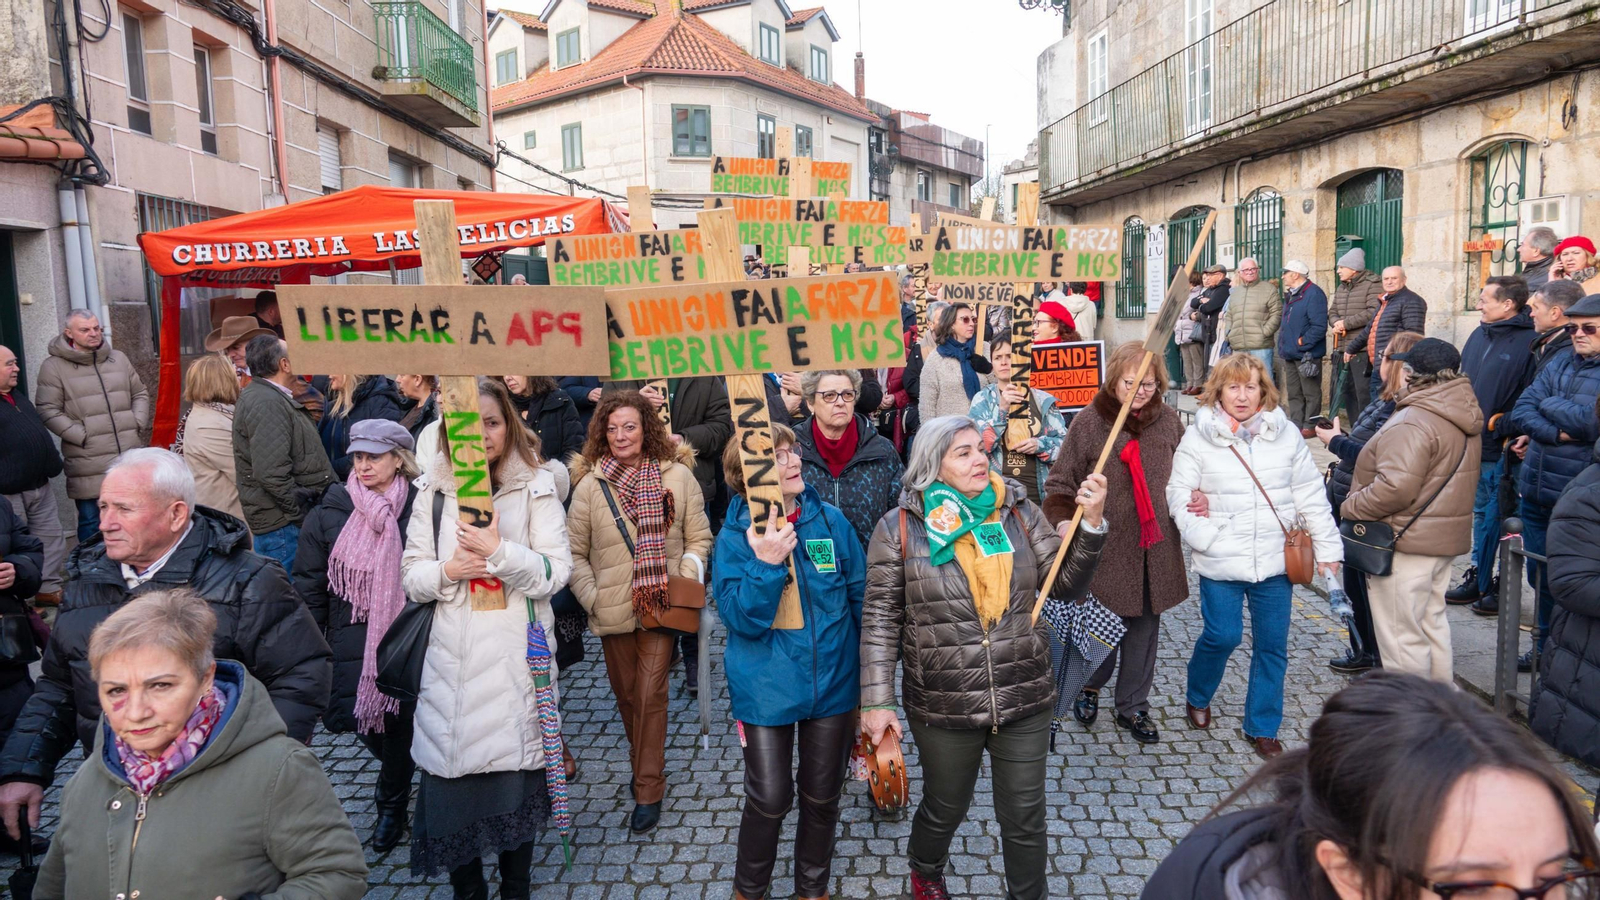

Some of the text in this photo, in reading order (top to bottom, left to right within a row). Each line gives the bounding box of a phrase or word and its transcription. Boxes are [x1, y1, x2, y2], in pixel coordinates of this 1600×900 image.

[713, 155, 725, 173] A
[729, 158, 775, 175] UNION
[811, 162, 848, 179] FORZA
[713, 174, 848, 197] BEMBRIVE MOS
[733, 199, 791, 221] UNION
[796, 200, 824, 221] FAI
[826, 202, 839, 222] A
[839, 201, 888, 223] FORZA
[172, 235, 350, 265] CHURRERIA
[457, 213, 576, 246] ELICIAS
[739, 222, 813, 245] MBRIVE
[823, 224, 835, 246] E
[848, 224, 888, 247] MOS
[935, 227, 1118, 251] A UNION FAI A FORZA
[554, 239, 570, 263] A
[574, 235, 637, 261] UNION
[640, 233, 671, 257] FAI
[673, 234, 686, 253] A
[854, 246, 864, 263] E
[873, 245, 906, 264] MOS
[554, 258, 661, 286] BEMBRIVE
[672, 256, 685, 281] E
[932, 251, 1119, 277] BEMBRIVE E MOS
[944, 284, 1013, 302] NON SE VE
[606, 277, 900, 339] A UNION FAI A FORZA
[296, 303, 455, 344] LIBERAR
[470, 311, 496, 345] A
[610, 319, 904, 380] BEMBRIVE E MOS
[1032, 346, 1098, 370] VENDE
[1031, 370, 1094, 388] BEMBRIVE
